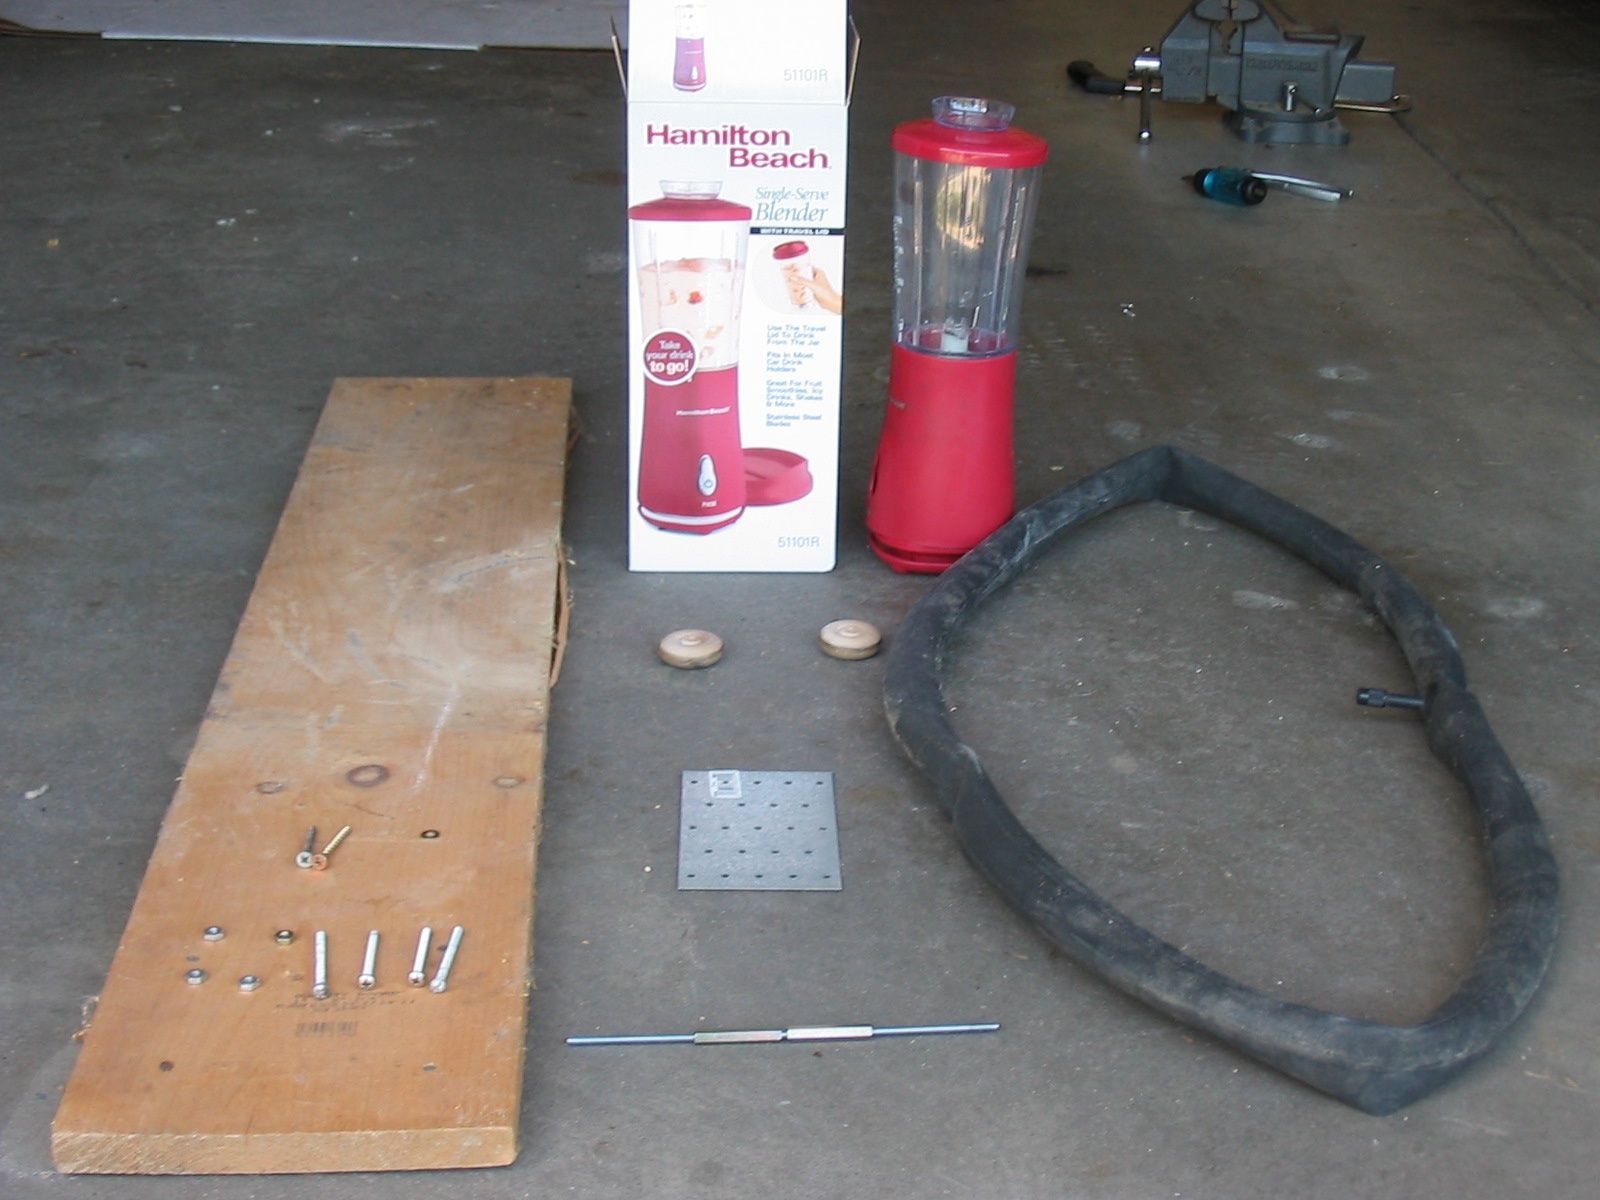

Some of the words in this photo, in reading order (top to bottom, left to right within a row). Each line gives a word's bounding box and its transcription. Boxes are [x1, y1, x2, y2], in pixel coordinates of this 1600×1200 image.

[783, 69, 829, 82] 51101R
[646, 124, 791, 146] Hamilton
[729, 147, 829, 169] Beach
[755, 186, 830, 203] Single-Serve
[755, 200, 829, 222] Blender
[659, 340, 681, 350] Take
[646, 352, 668, 362] your
[669, 350, 694, 359] drink
[649, 360, 665, 373] to
[666, 359, 689, 376] go!
[778, 535, 820, 548] 51101R
